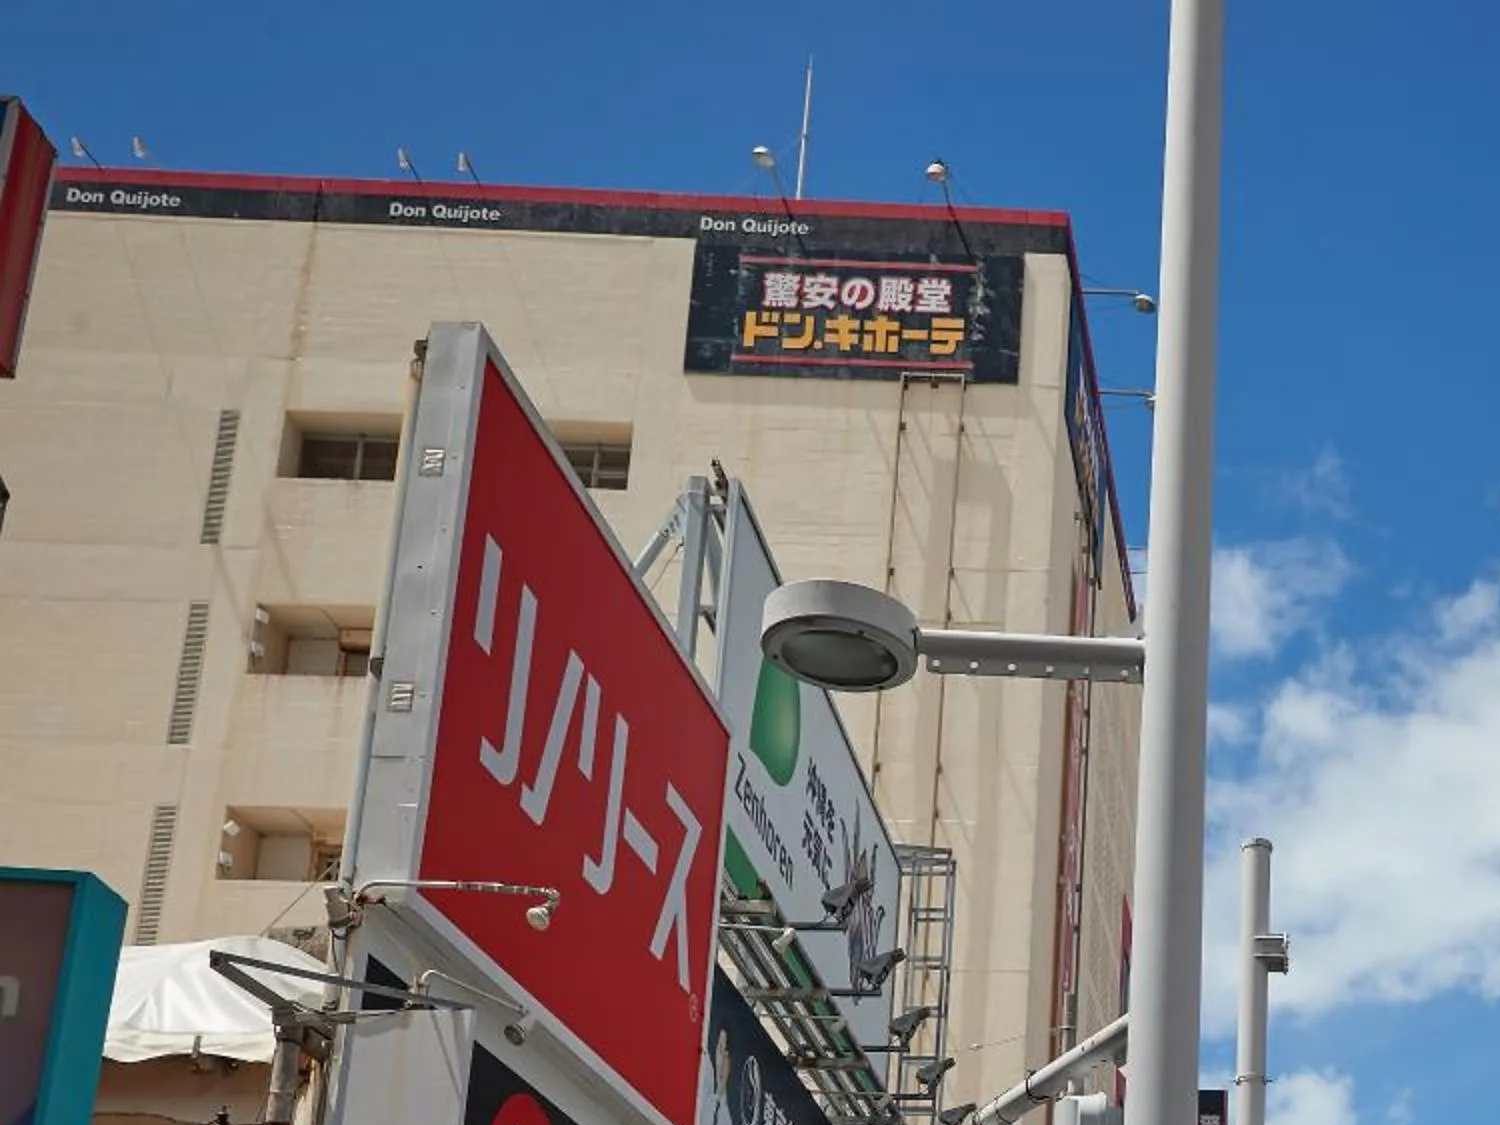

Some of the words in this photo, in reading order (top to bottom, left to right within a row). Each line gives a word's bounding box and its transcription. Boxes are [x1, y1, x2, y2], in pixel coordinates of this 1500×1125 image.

[66, 186, 104, 204] Don
[110, 189, 181, 209] Quijote
[389, 202, 427, 219] Don
[431, 203, 501, 223] Quijote
[700, 216, 736, 233] Don
[741, 218, 810, 237] Quijote
[762, 271, 953, 314] 驚安の殿堂
